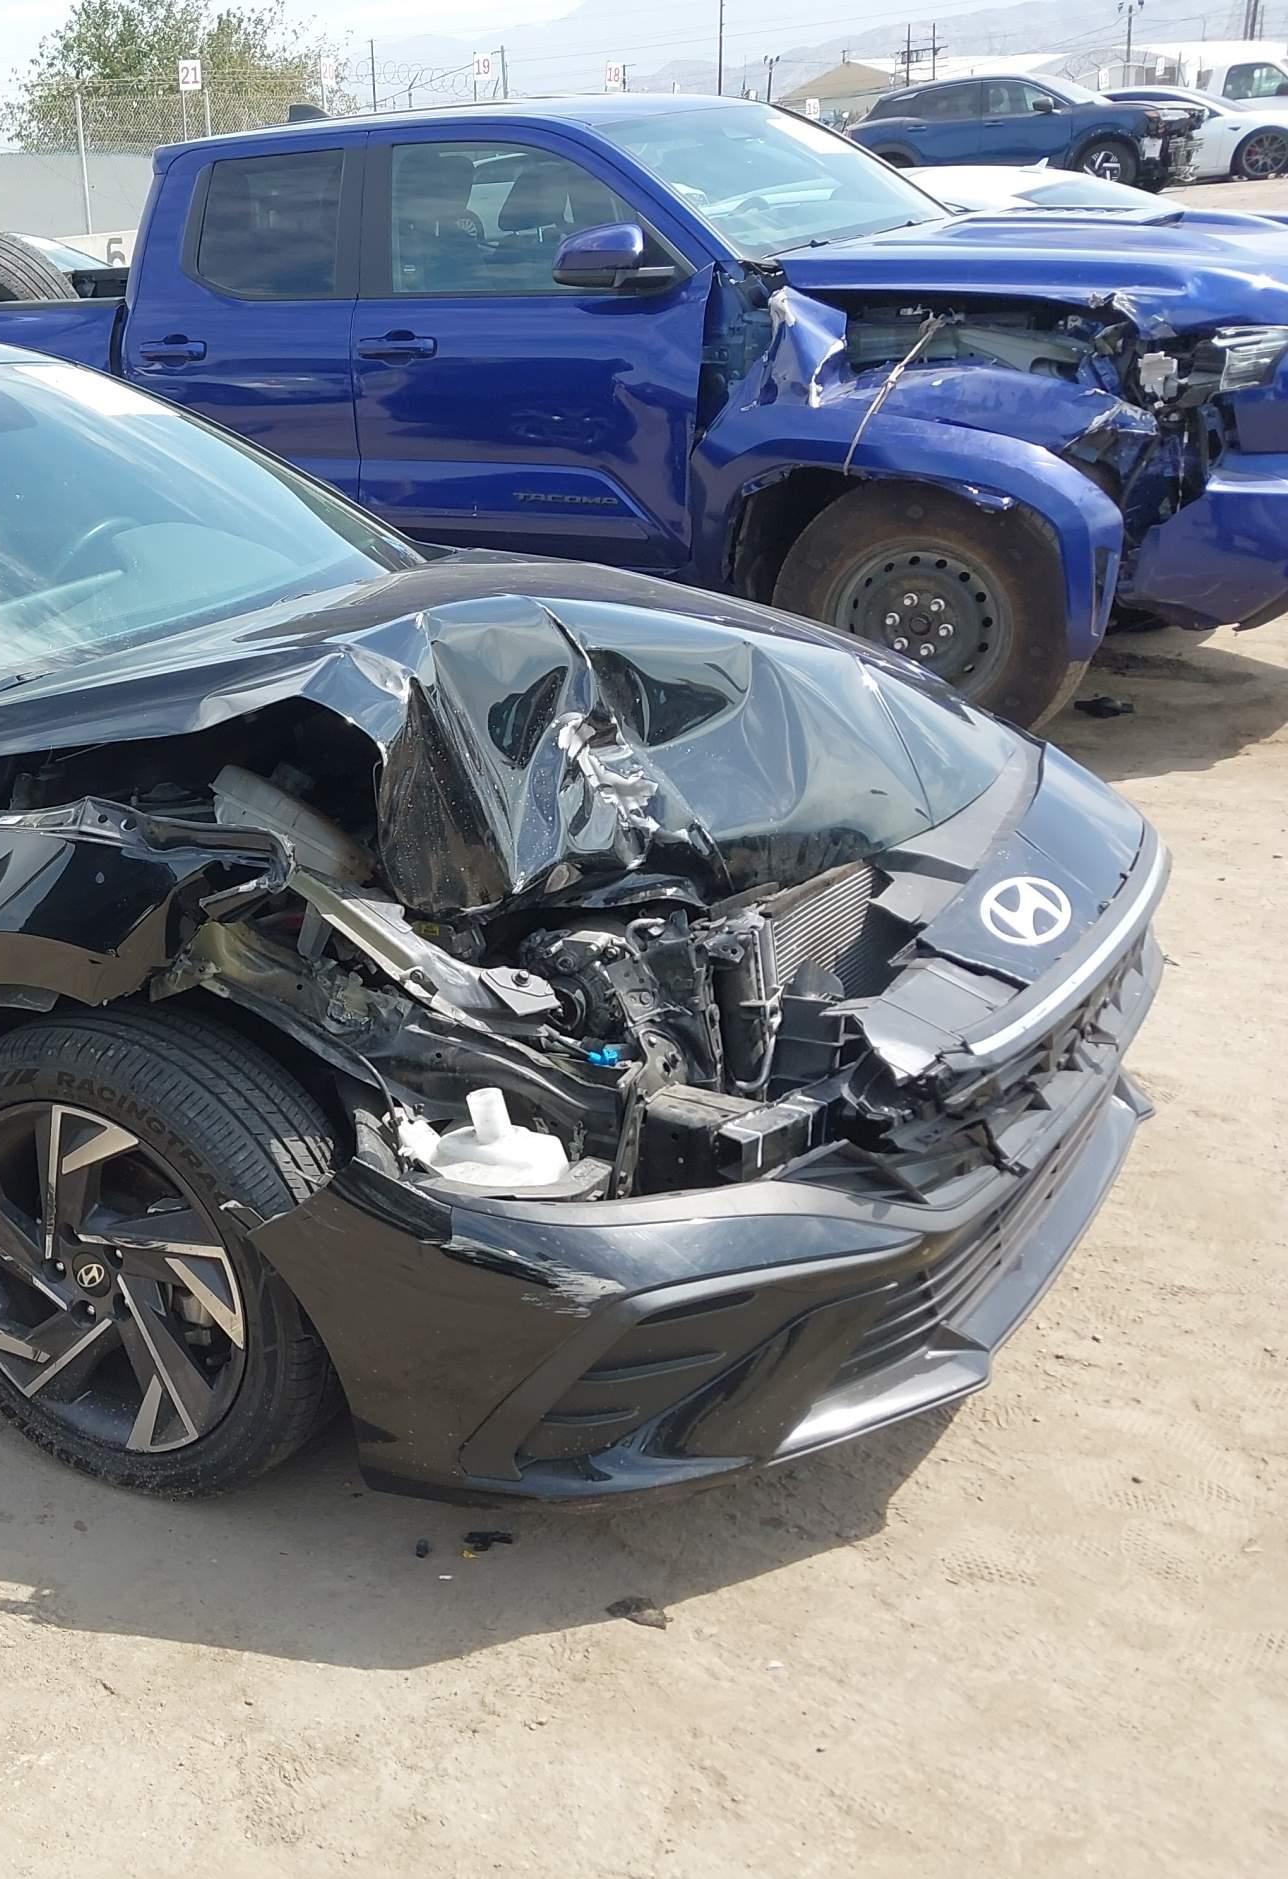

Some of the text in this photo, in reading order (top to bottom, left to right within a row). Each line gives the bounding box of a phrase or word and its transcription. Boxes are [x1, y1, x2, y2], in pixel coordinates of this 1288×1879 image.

[475, 58, 490, 75] 19
[607, 67, 621, 82] 18
[181, 66, 200, 84] 21
[512, 492, 618, 505] TACOMA
